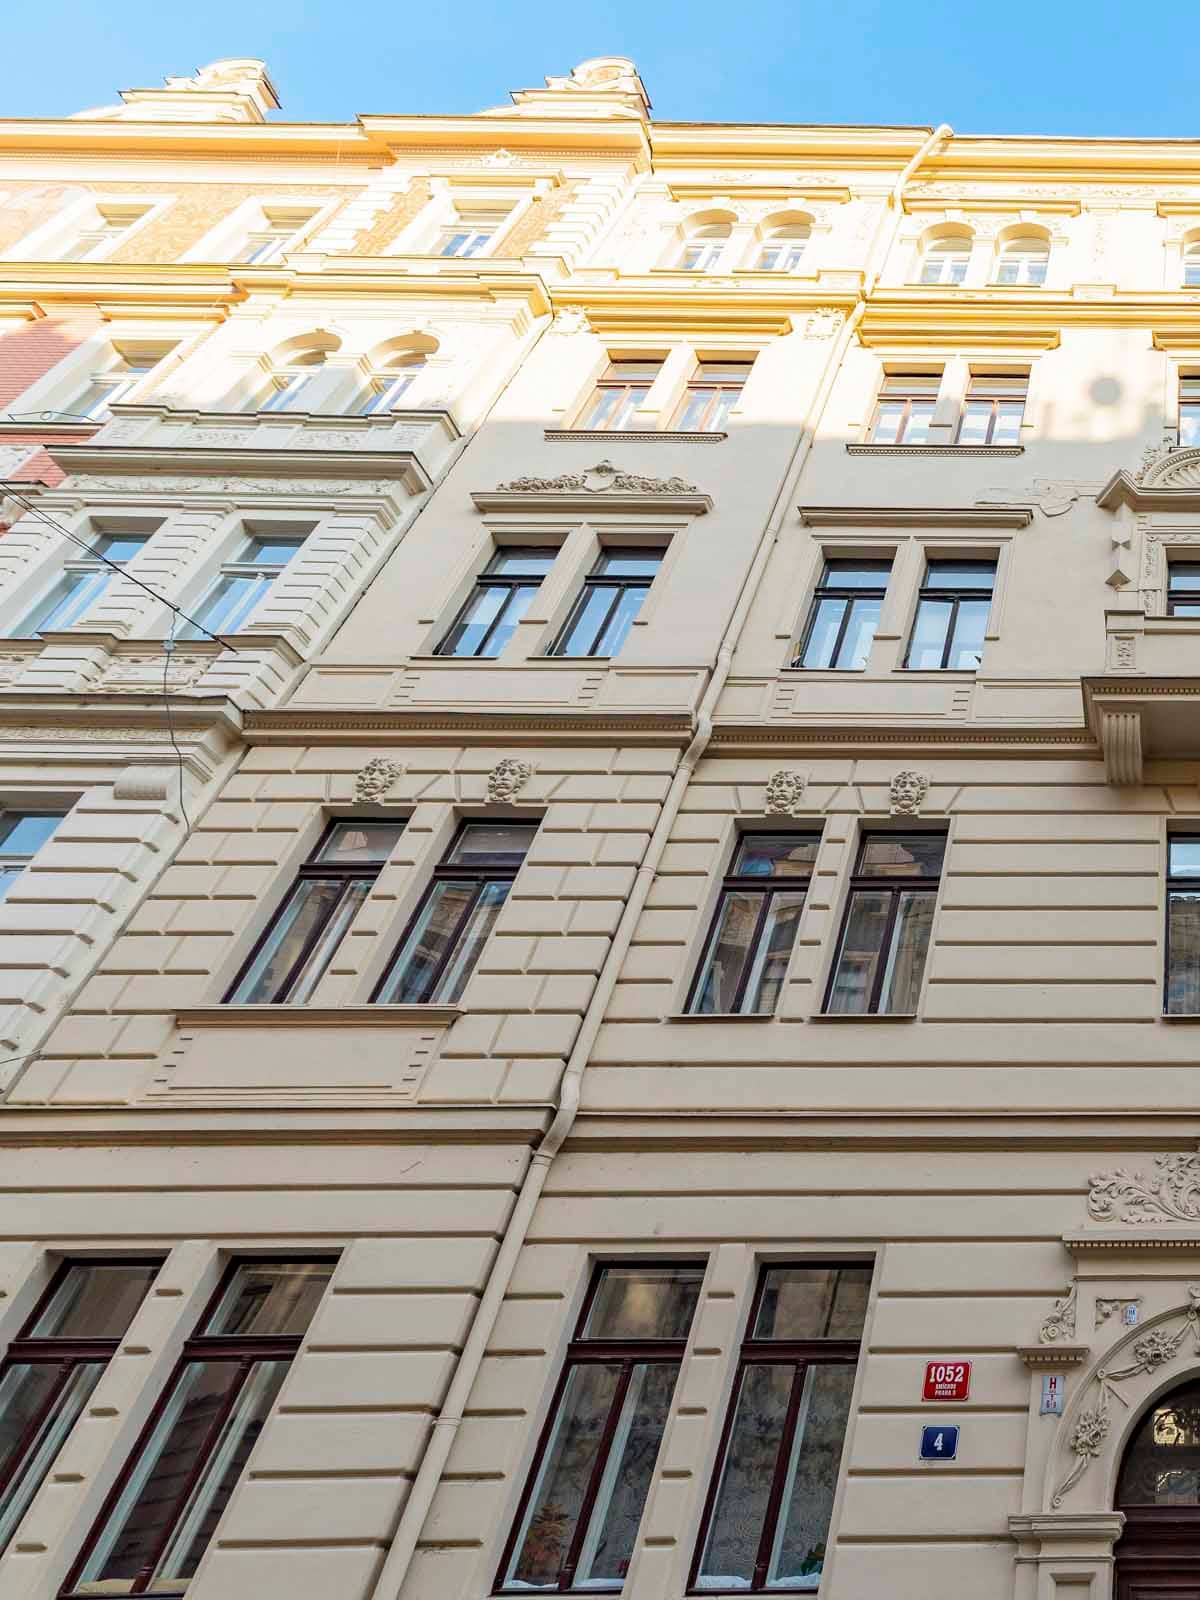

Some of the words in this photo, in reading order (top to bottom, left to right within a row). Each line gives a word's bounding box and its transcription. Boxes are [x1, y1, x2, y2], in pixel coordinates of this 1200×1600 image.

[930, 1367, 964, 1383] 1052
[1050, 1377, 1056, 1389] H
[934, 1433, 943, 1451] 4
